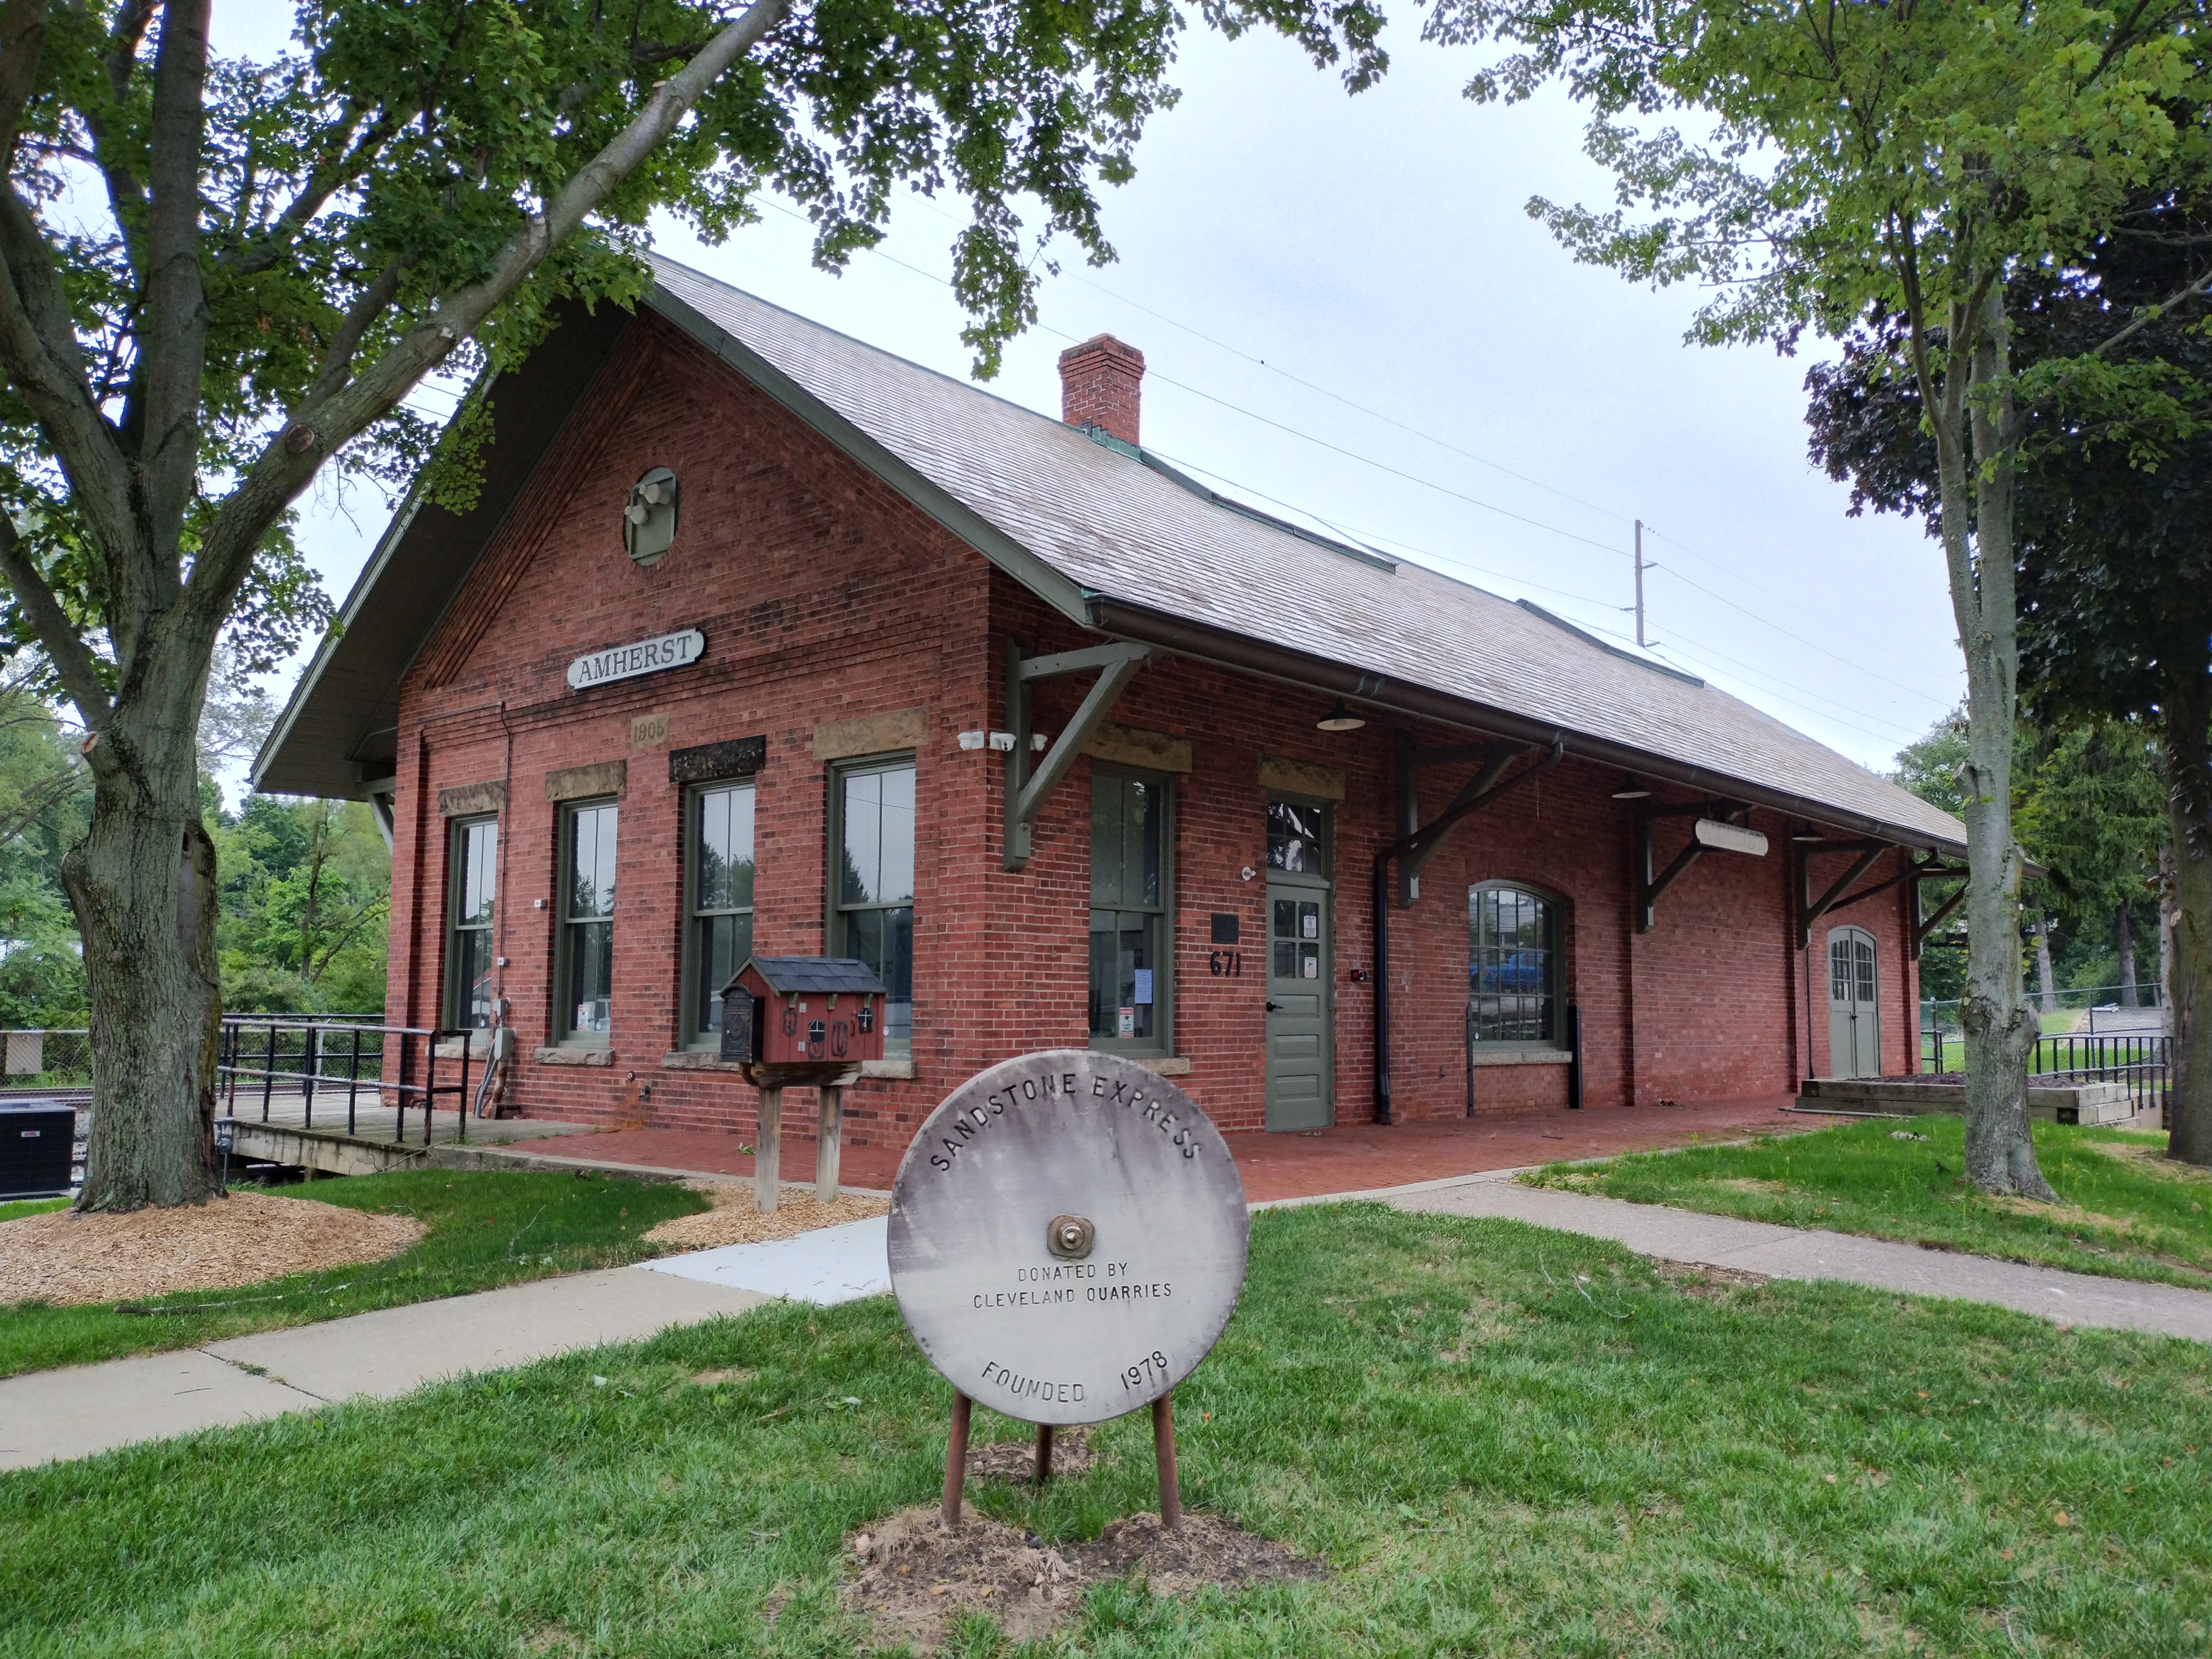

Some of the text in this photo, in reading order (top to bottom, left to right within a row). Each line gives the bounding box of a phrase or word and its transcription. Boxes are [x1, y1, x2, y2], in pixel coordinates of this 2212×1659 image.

[578, 634, 692, 683] AMHERST
[634, 719, 665, 743] 1905
[1210, 951, 1241, 977] 671
[930, 1073, 1202, 1172] SANDSTONE EXPRESS
[1018, 1262, 1128, 1282] DONATED BY
[973, 1283, 1172, 1309] CLEVELAND QUARRIES
[981, 1350, 1168, 1403] FOUNDED 1978
